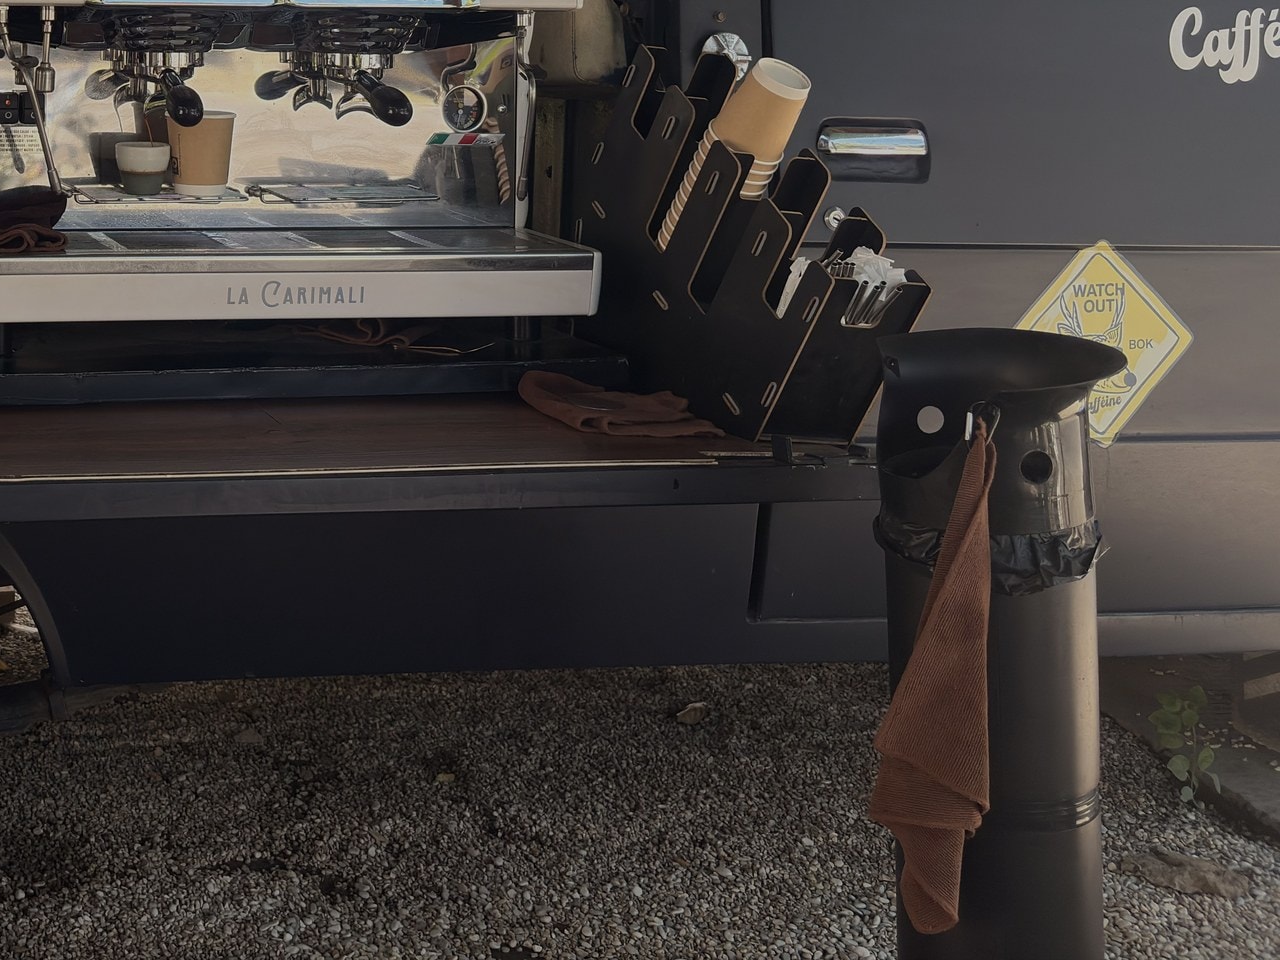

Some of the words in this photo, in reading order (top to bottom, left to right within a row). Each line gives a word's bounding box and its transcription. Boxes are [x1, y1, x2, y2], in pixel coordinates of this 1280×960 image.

[226, 286, 249, 305] LA
[261, 280, 365, 308] CARIMALI
[1072, 282, 1125, 298] WATCH
[1129, 338, 1154, 349] BOK
